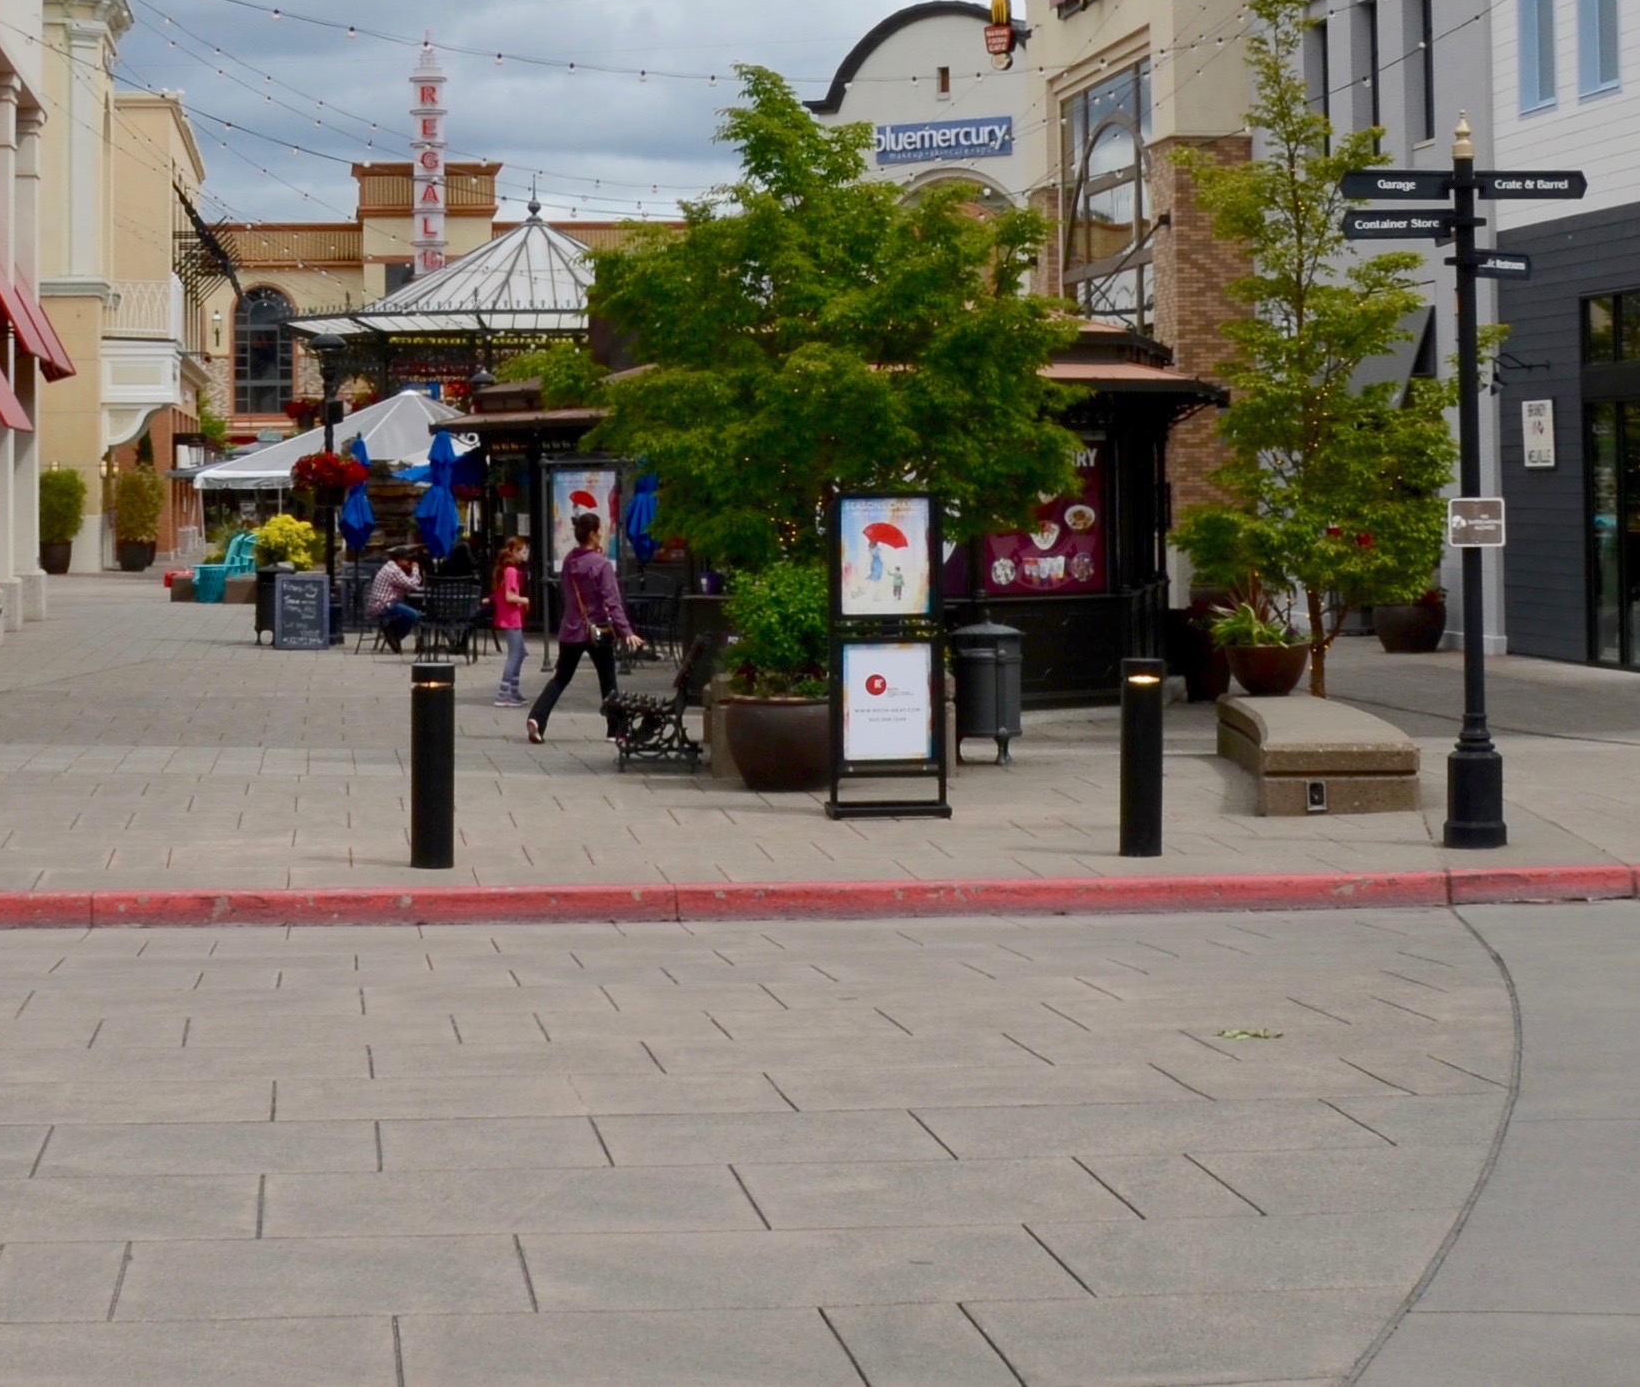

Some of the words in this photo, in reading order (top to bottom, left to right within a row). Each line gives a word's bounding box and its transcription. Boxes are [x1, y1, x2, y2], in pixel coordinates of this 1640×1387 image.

[872, 124, 1009, 151] bluemercury
[419, 85, 439, 238] REGAL
[1377, 179, 1417, 192] Garage
[1494, 179, 1523, 190] Crate
[1525, 180, 1535, 189] &
[1537, 179, 1569, 190] Barrel
[1354, 219, 1408, 231] Container
[1411, 218, 1440, 229] Store
